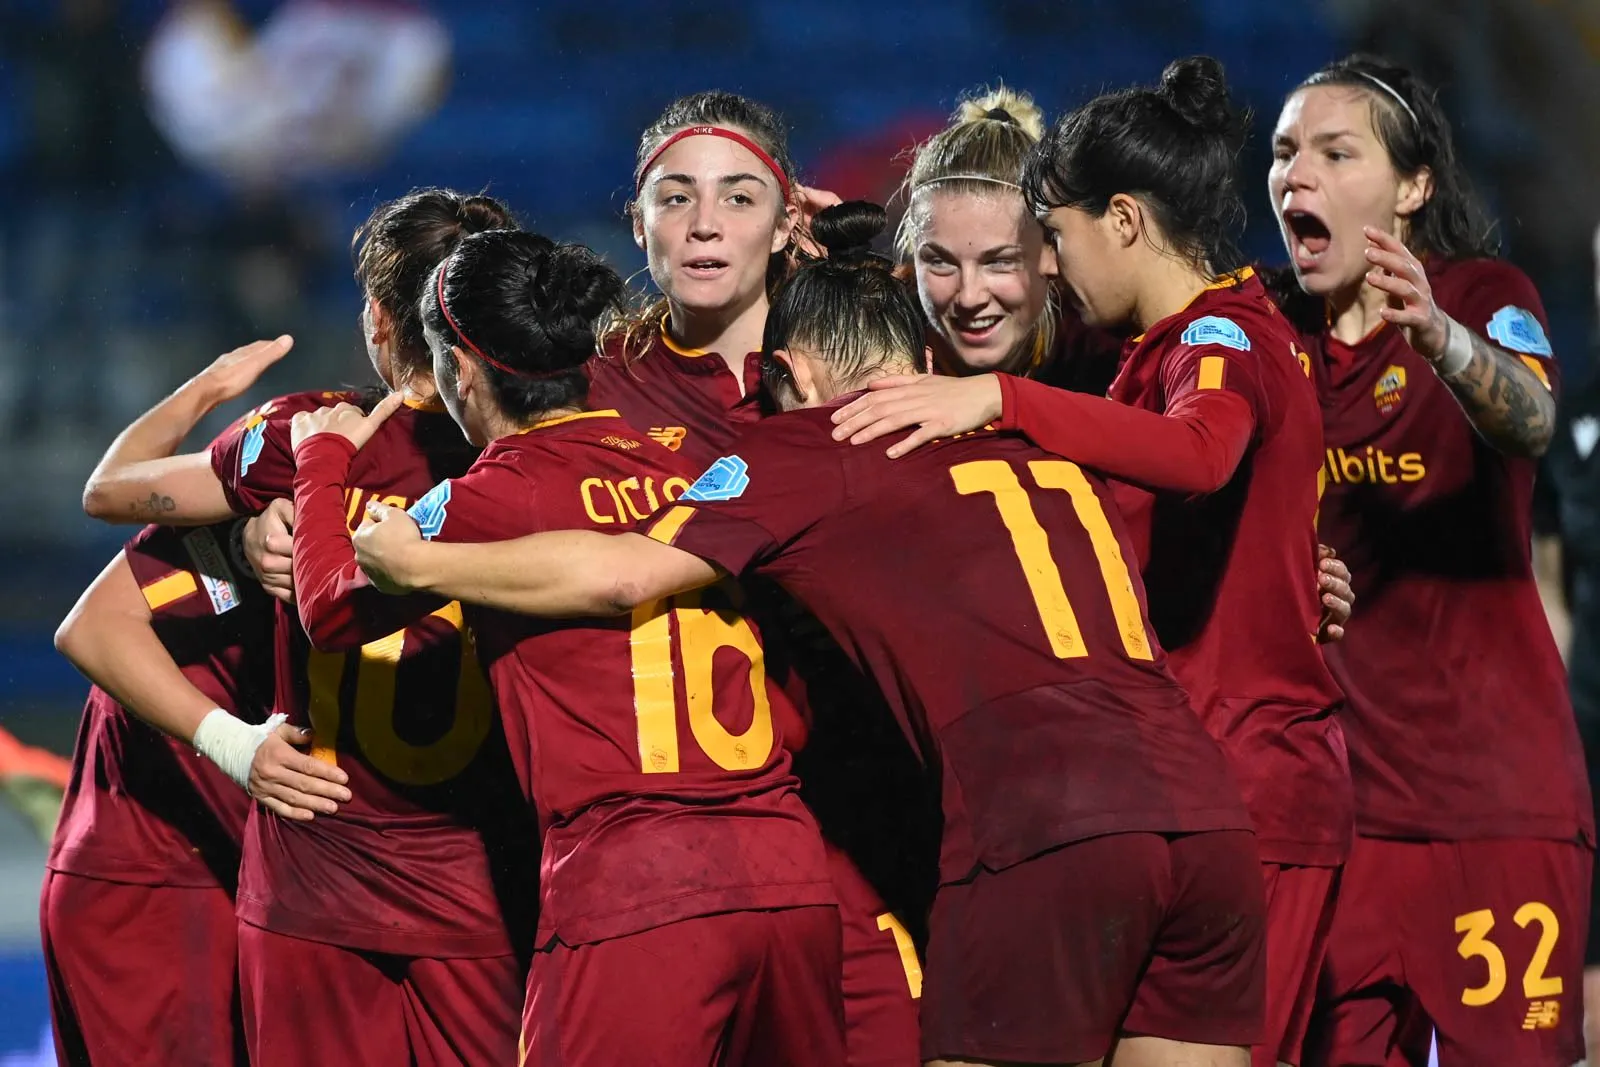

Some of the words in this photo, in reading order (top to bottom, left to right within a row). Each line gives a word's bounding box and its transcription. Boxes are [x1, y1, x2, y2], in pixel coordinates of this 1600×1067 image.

[1327, 446, 1426, 484] lbits
[949, 460, 1154, 661] 11
[306, 600, 493, 786] 10
[630, 592, 774, 774] 16
[1455, 902, 1563, 1006] 32
